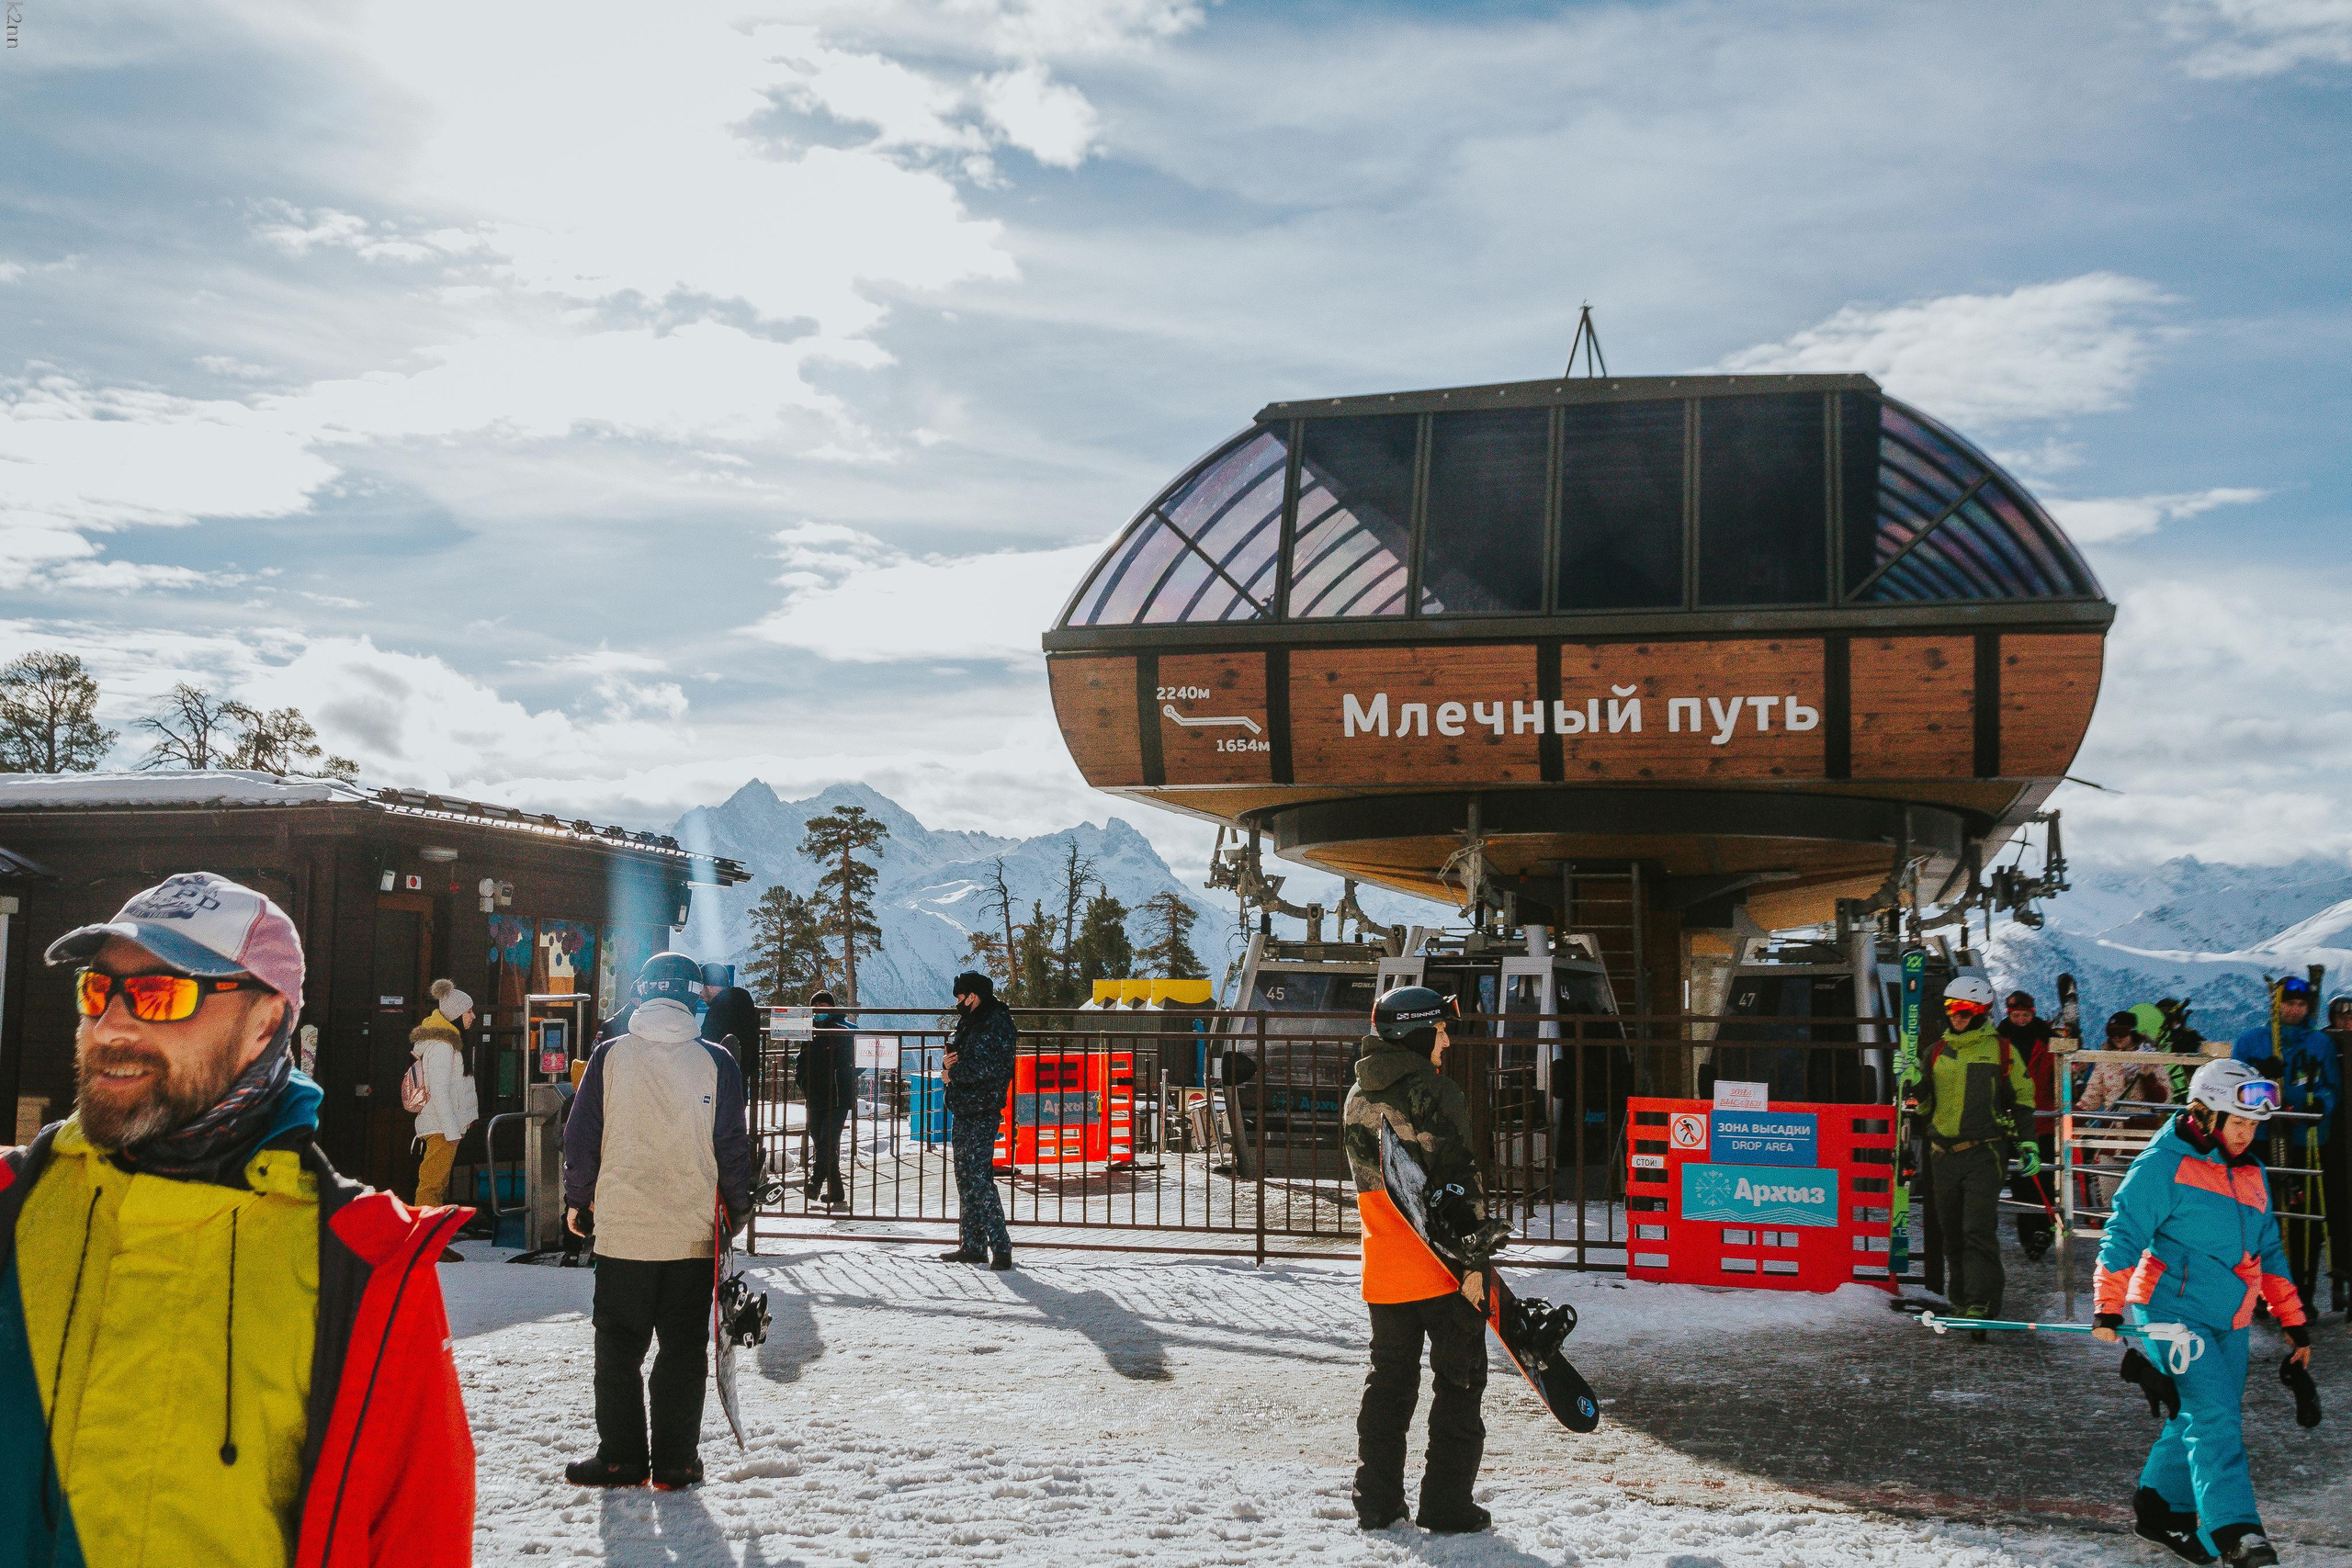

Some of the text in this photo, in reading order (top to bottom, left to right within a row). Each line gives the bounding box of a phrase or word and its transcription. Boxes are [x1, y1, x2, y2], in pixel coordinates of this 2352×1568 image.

[1157, 686, 1210, 700] 2240м
[1342, 683, 1820, 746] Млечный путь
[1217, 739, 1271, 752] 1654м
[1266, 987, 1285, 1000] 45
[1739, 992, 1756, 1007] 47
[1410, 1009, 1442, 1019] SINNER
[1717, 1122, 1811, 1137] ЗОНА ВЫСАДКИ
[1732, 1140, 1794, 1152] DROP AREA
[1635, 1156, 1657, 1167] СТОЙ!
[1734, 1178, 1826, 1207] Архыз
